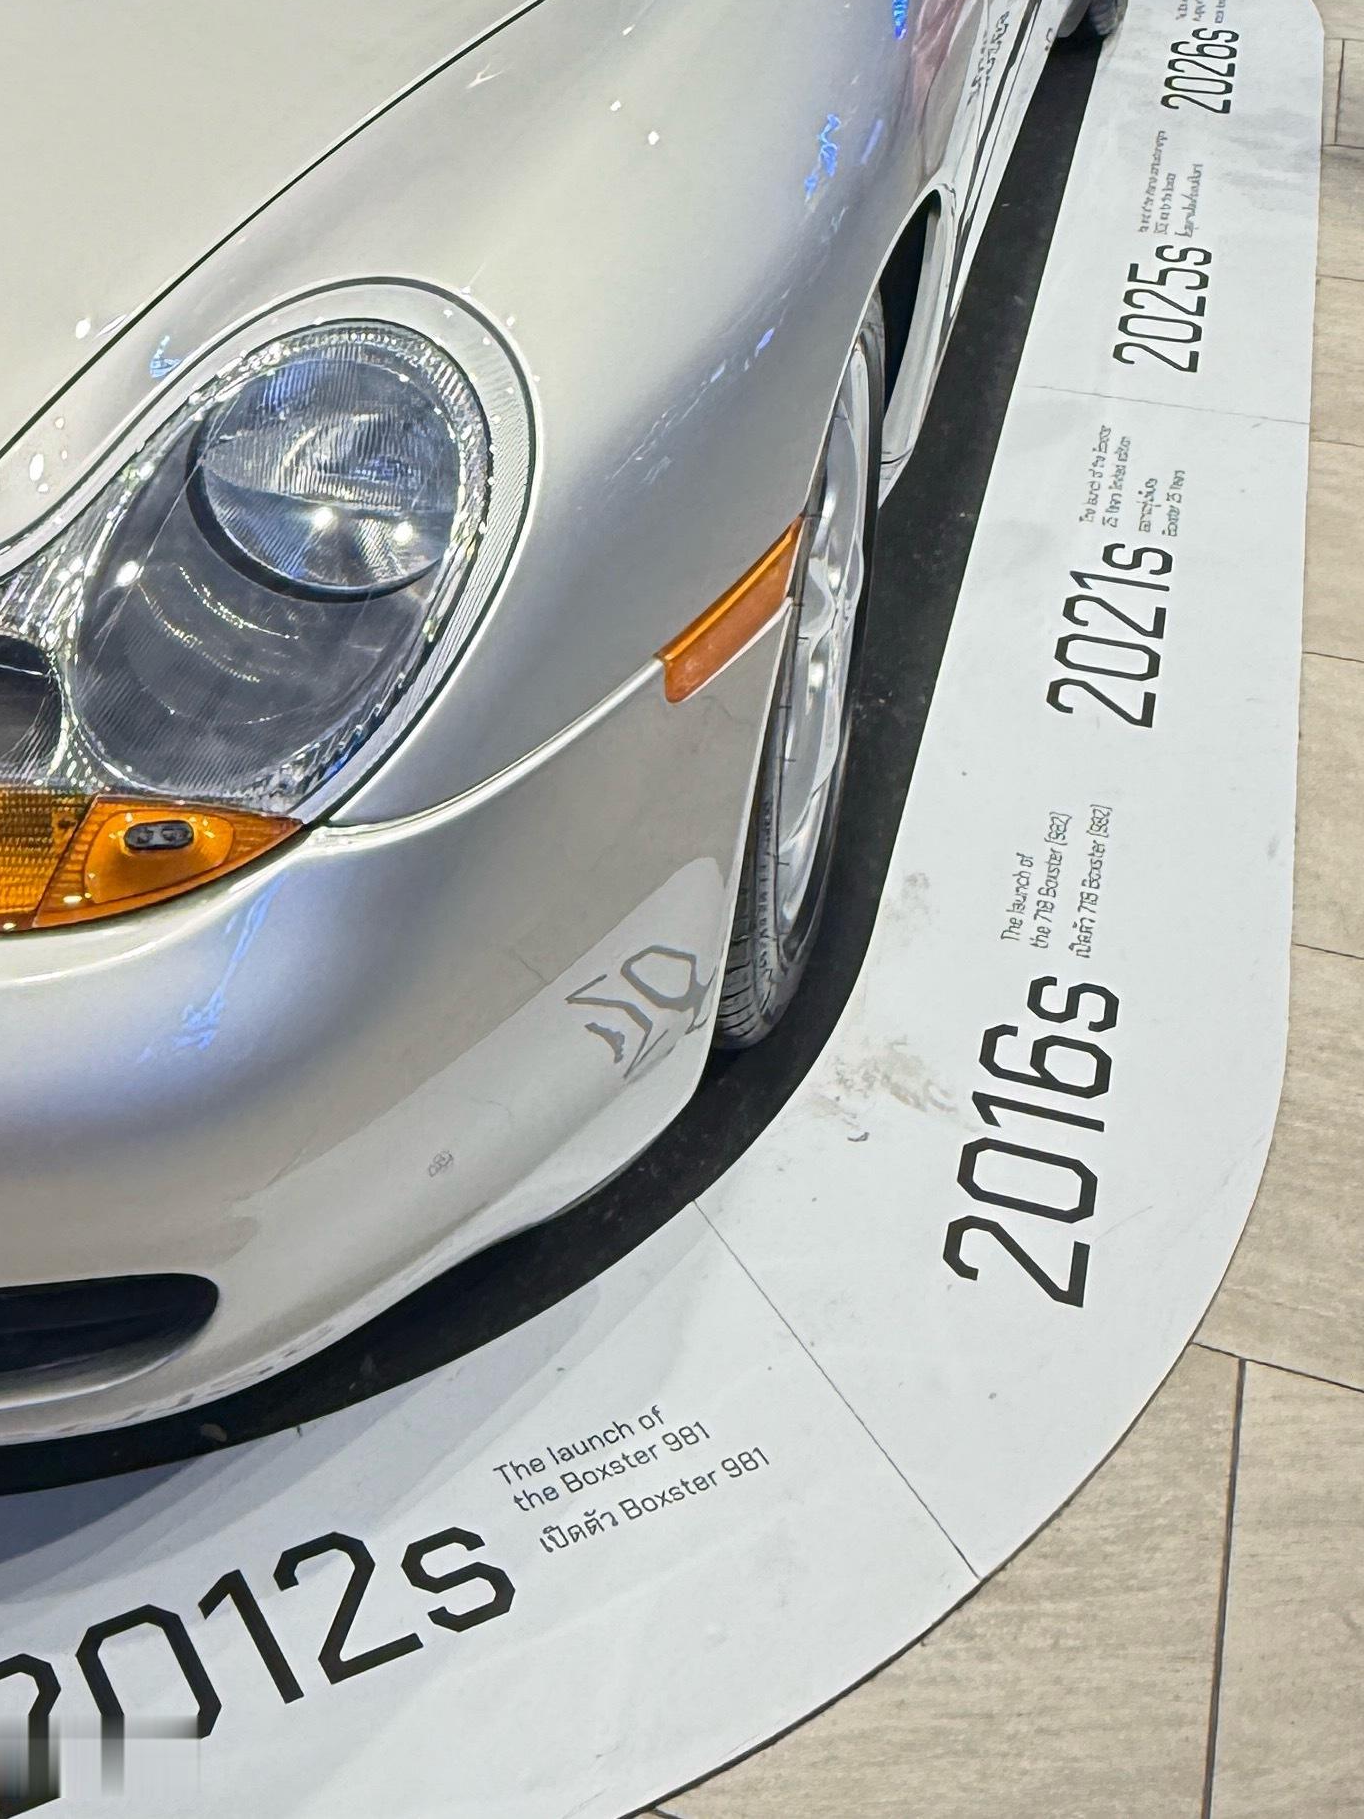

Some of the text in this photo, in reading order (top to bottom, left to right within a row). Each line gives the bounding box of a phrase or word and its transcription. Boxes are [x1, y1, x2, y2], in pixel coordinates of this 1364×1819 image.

[1160, 27, 1239, 115] 2026s
[1112, 244, 1212, 373] 2025s
[1046, 540, 1175, 730] 2021s
[1001, 917, 1024, 942] The
[942, 974, 1121, 1309] 2016s
[493, 1404, 665, 1486] The launch of
[513, 1421, 711, 1513] the Boxster 981
[539, 1446, 771, 1554] เปิดตัว Boxster 981
